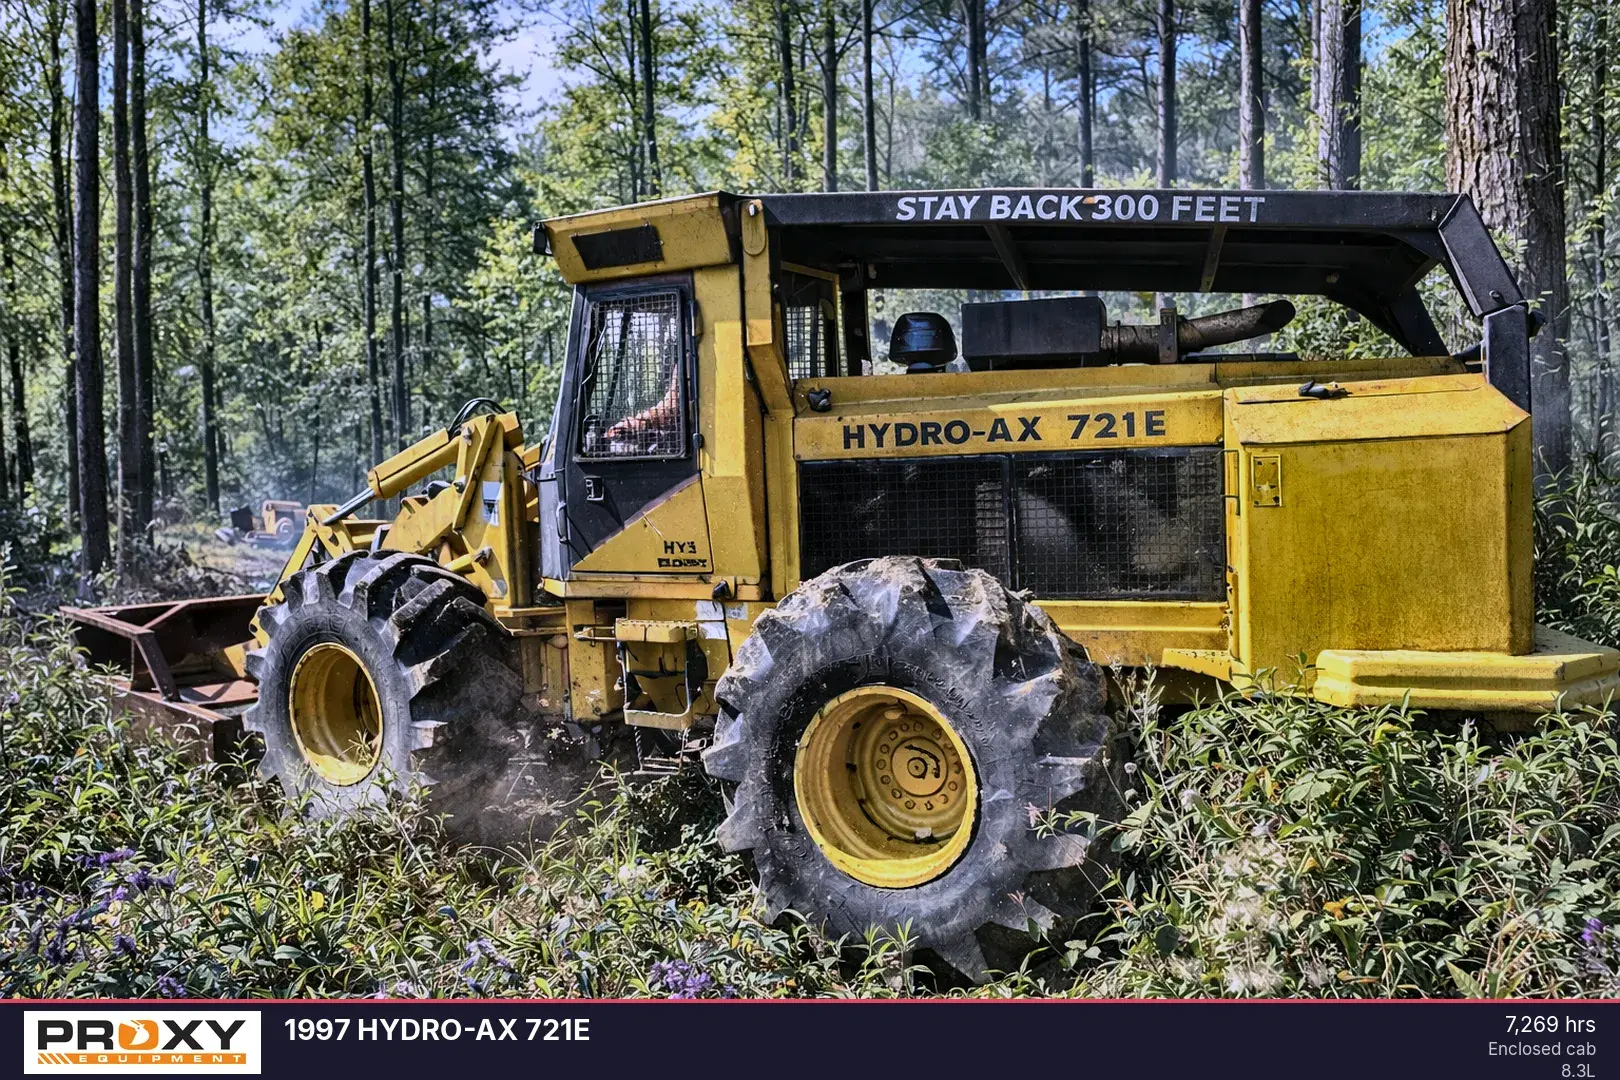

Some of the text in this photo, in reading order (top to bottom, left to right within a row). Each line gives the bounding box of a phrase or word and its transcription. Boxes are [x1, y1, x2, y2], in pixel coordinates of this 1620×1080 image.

[895, 194, 1265, 223] STAY BACK 300 FEET
[842, 410, 1166, 449] HYDRO-AX 721E
